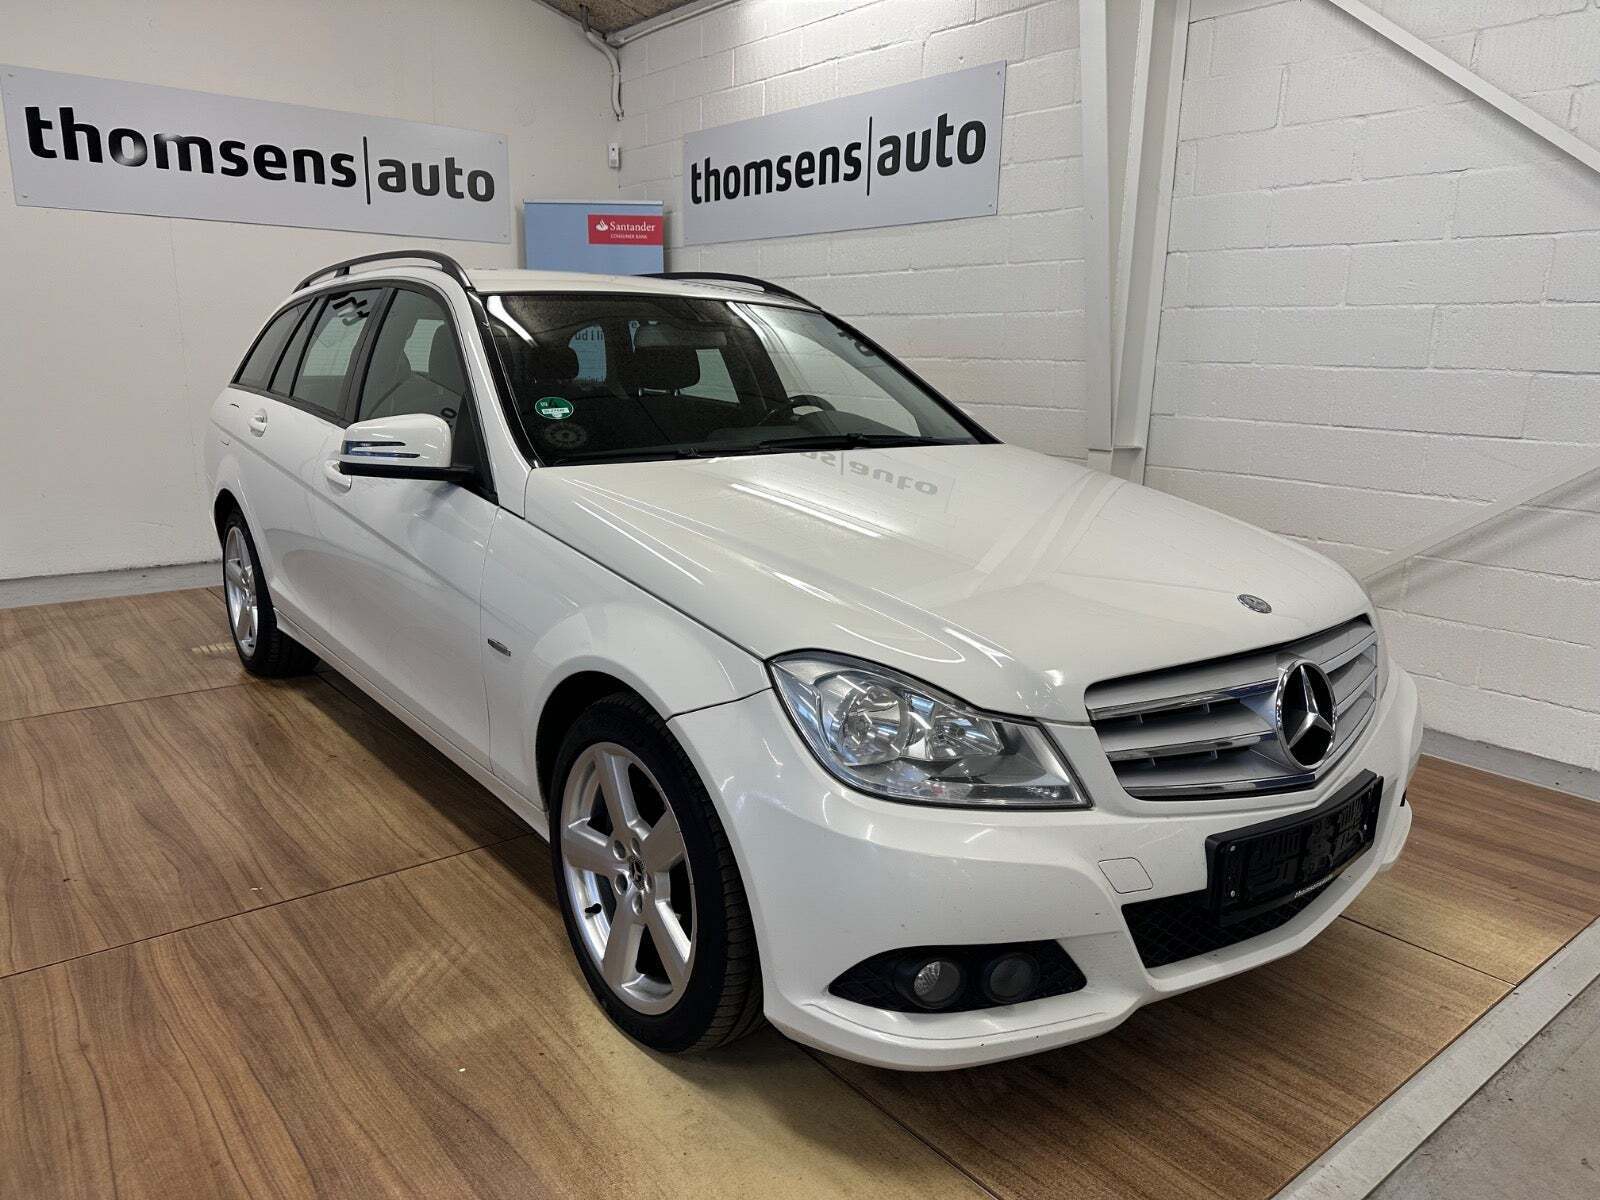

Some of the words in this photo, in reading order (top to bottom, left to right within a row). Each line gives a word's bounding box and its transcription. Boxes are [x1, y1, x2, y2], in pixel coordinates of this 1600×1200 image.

[24, 106, 357, 187] thomsens
[377, 156, 495, 202] auto
[690, 141, 862, 205] thomsens
[876, 112, 987, 177] auto
[609, 221, 656, 232] Santander
